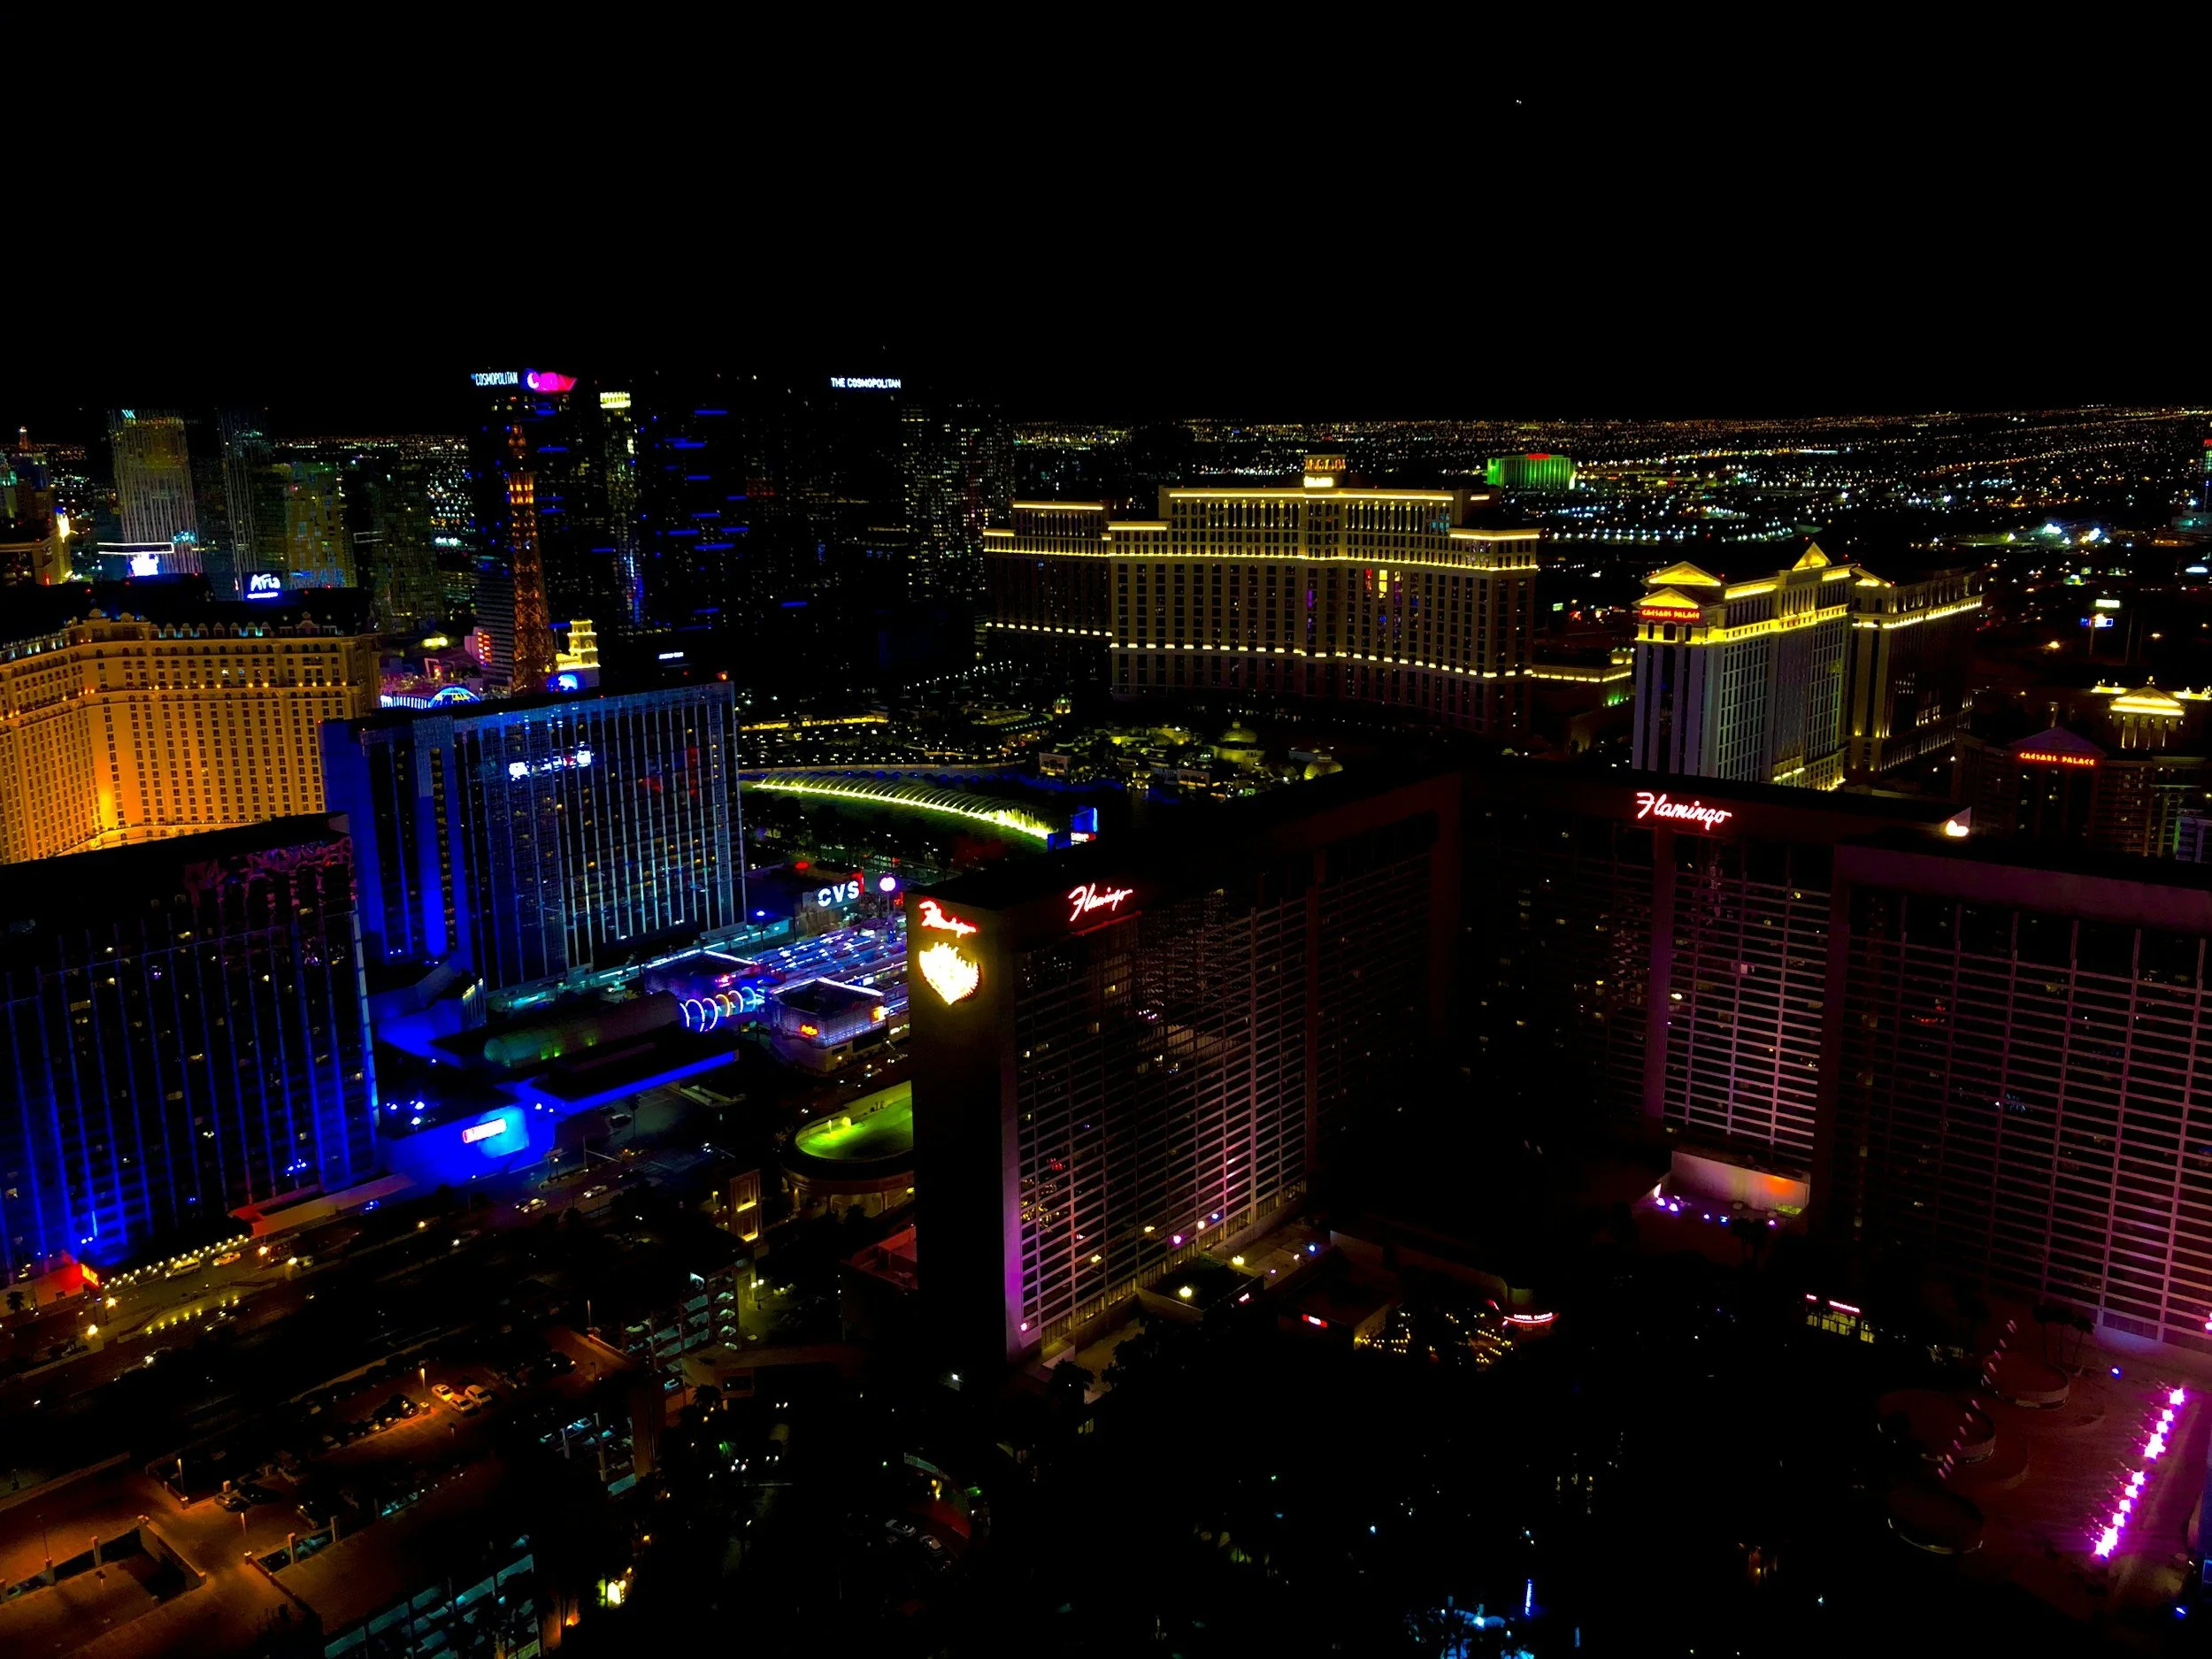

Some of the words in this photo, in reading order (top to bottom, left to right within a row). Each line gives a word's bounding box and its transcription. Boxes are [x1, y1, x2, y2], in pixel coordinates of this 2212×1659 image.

[475, 372, 518, 386] COSMOPOLITAN
[830, 377, 846, 388] THE
[847, 377, 902, 389] COSMOPOLITAN
[1673, 611, 1700, 619] PALACE
[2019, 752, 2057, 762] CAESARS
[2062, 756, 2095, 766] PALACE
[1636, 792, 1732, 831] Flamingo
[818, 880, 860, 907] CVS
